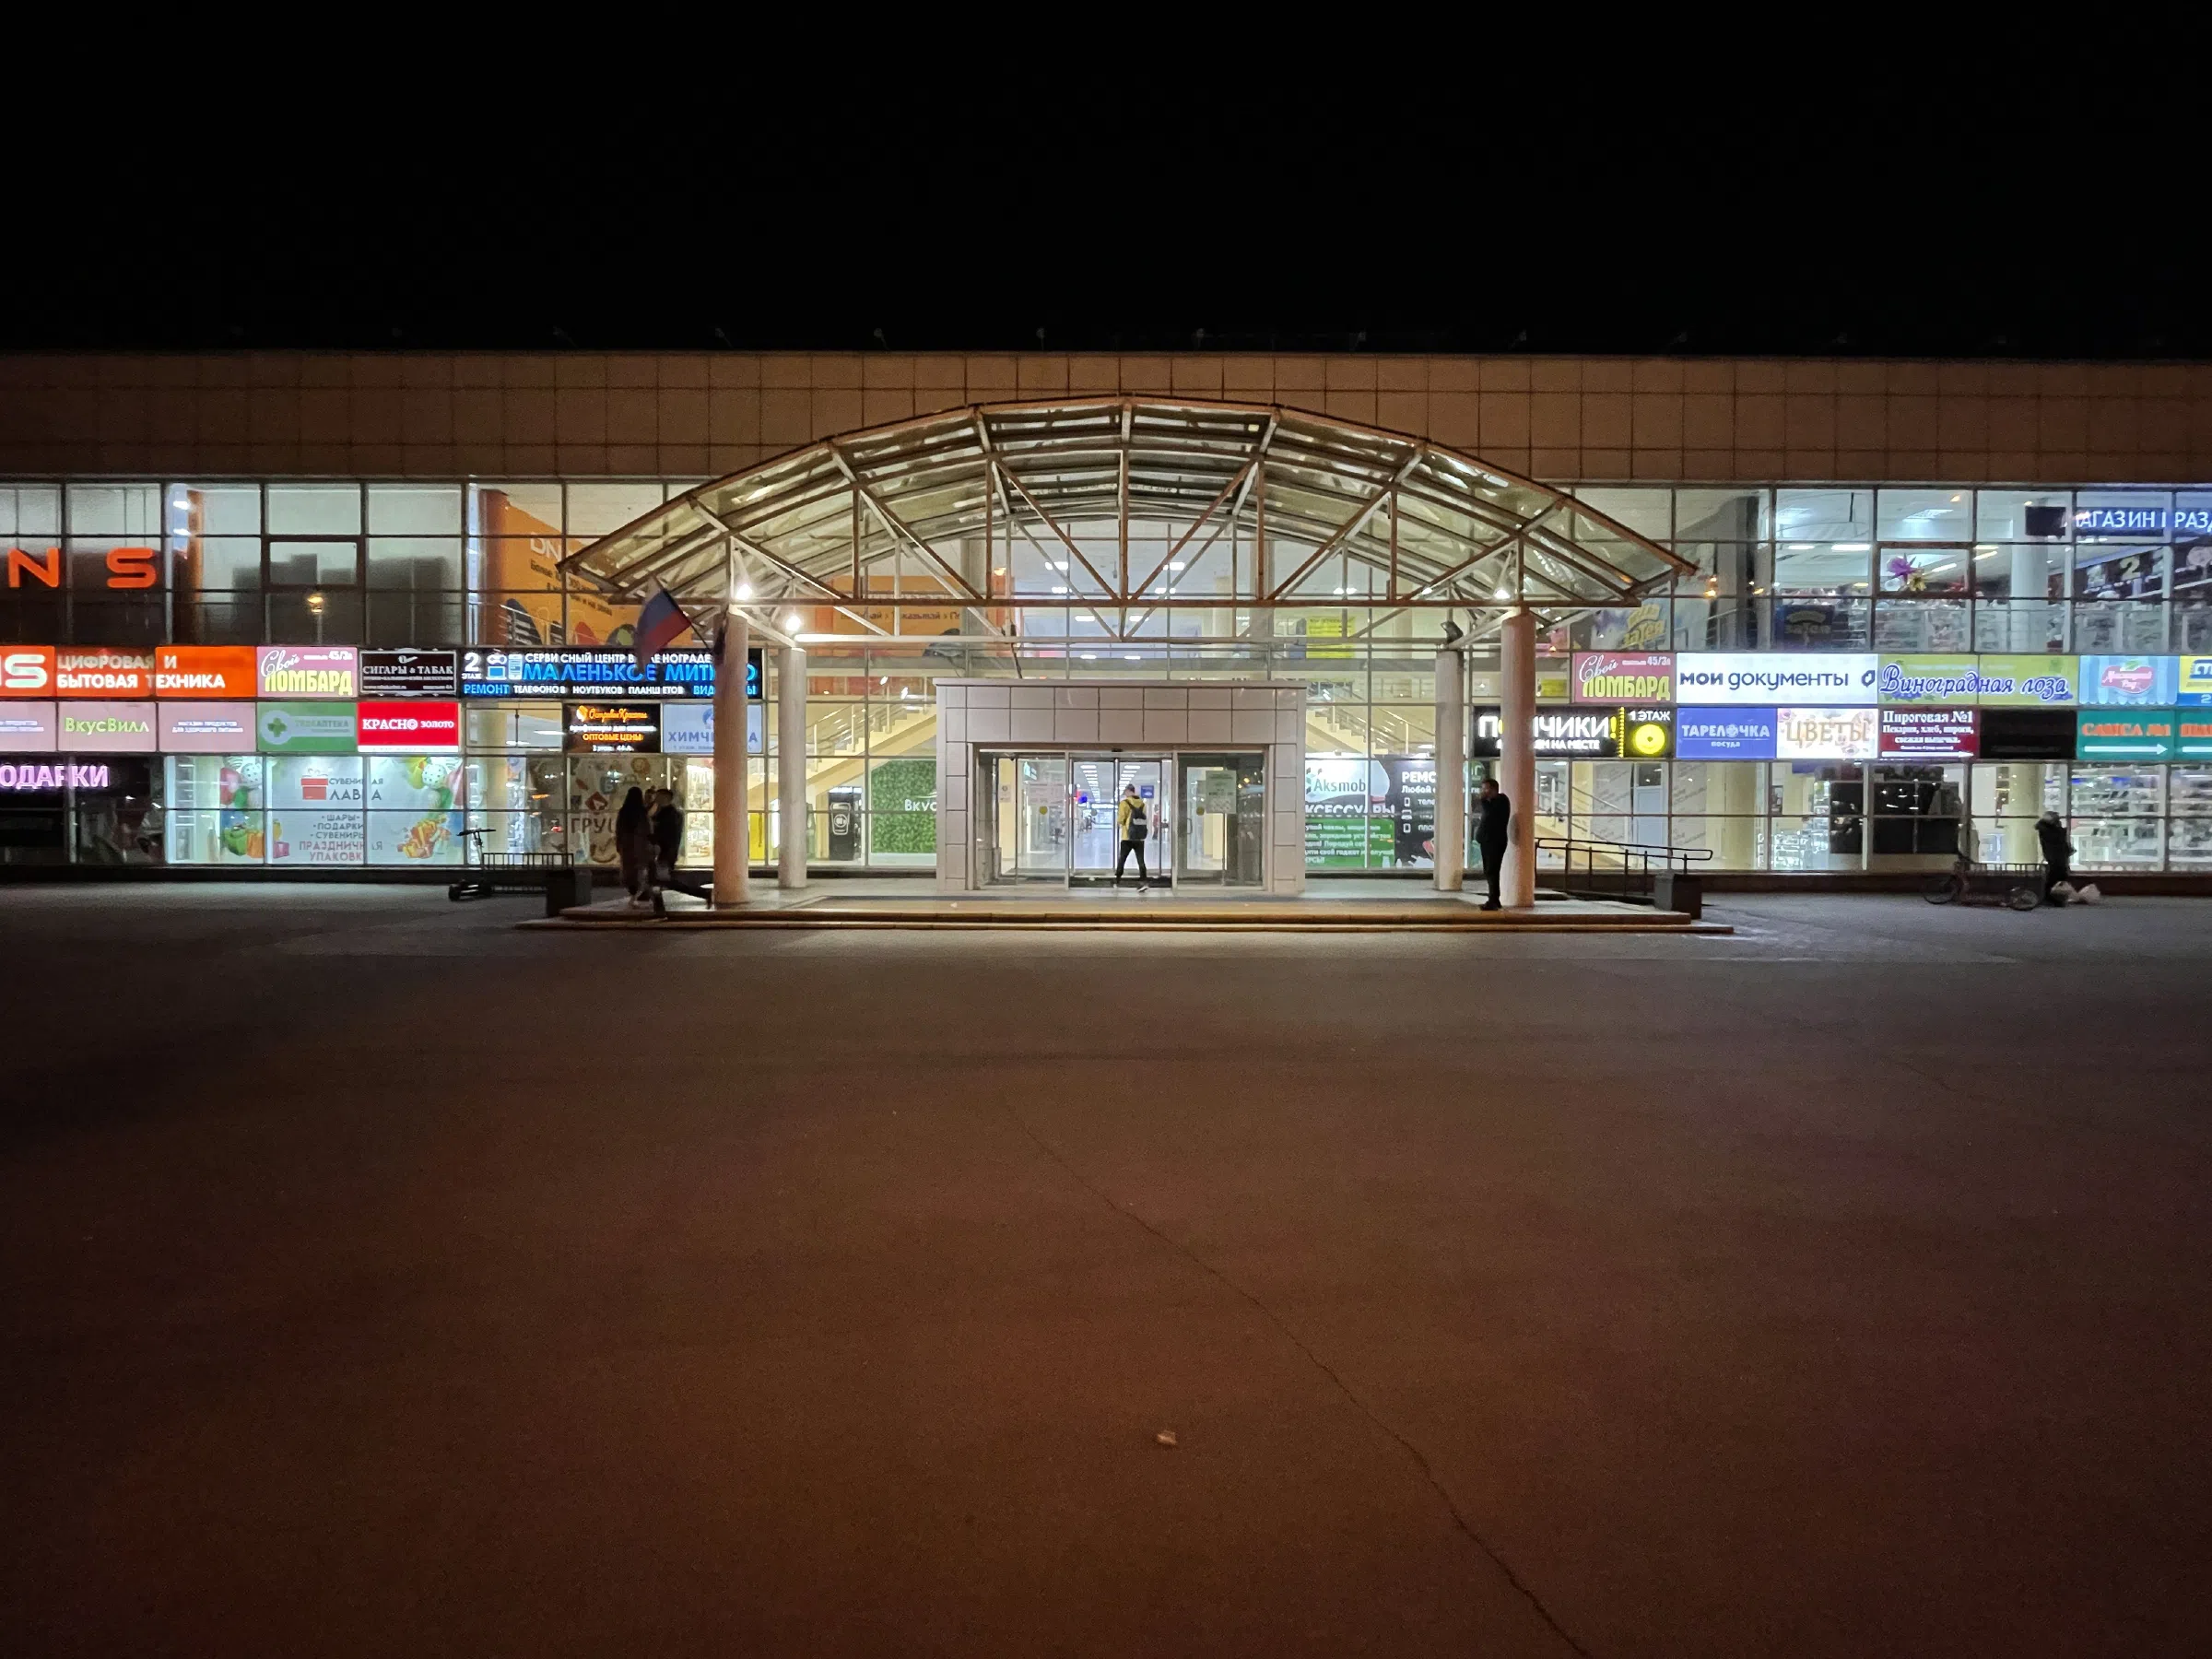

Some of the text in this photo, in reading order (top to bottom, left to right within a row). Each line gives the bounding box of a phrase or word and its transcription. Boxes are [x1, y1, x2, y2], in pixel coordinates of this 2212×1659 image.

[57, 654, 177, 671] ЦИФРОВАЯ И
[261, 651, 300, 677] Свой
[465, 653, 480, 672] 2
[525, 653, 592, 663] СЕРВИСНЫЙ
[594, 654, 627, 664] ЦЕНТР
[0, 654, 47, 688] S
[362, 665, 406, 674] СИГАРЫ
[418, 665, 453, 674] ТАБАК
[1579, 654, 1618, 682] Свой
[57, 674, 225, 688] БЫТОВАЯ ТЕХНИКА
[265, 670, 352, 695] ЛОМБАРД
[1583, 676, 1671, 700] ЛОМБАРД
[1680, 673, 1849, 690] мои документы
[1880, 665, 2015, 699] Виноградная
[2020, 677, 2069, 700] лоза
[464, 685, 509, 694] РЕМОНТ
[513, 685, 566, 694] ТЕЛЕФОНОВ
[572, 686, 623, 694] НОУТБУКОВ
[629, 686, 685, 694] ПЛАНШЕТОВ
[1639, 712, 1671, 721] ЭТАЖ
[1883, 711, 1948, 724] Пироговая
[65, 718, 150, 735] ВкусВилл
[1682, 724, 1770, 737] ТАРЕЛОЧКА
[582, 733, 619, 741] ОПТОВЫЕ
[668, 731, 759, 743] ХИМЧА
[1785, 721, 1869, 748] ЦВЕТЫ
[329, 789, 382, 800] ЛАВА
[310, 852, 363, 861] УПАКОВК
